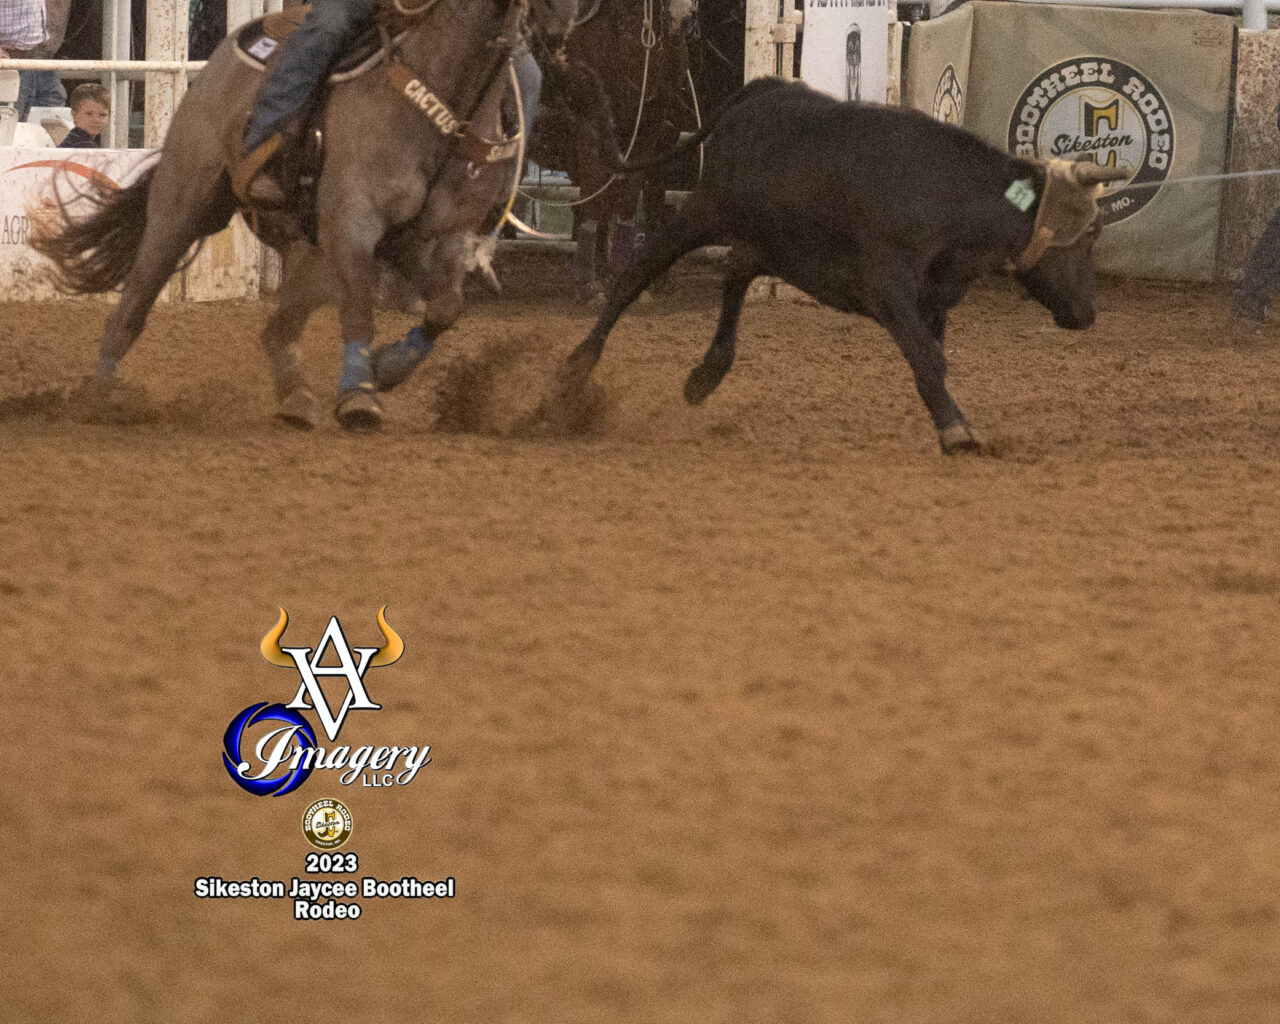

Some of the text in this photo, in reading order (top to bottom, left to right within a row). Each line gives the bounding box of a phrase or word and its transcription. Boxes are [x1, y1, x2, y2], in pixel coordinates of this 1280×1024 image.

[404, 78, 460, 135] CACTUS
[1121, 76, 1171, 171] RODEO
[1049, 132, 1135, 157] Sikeston
